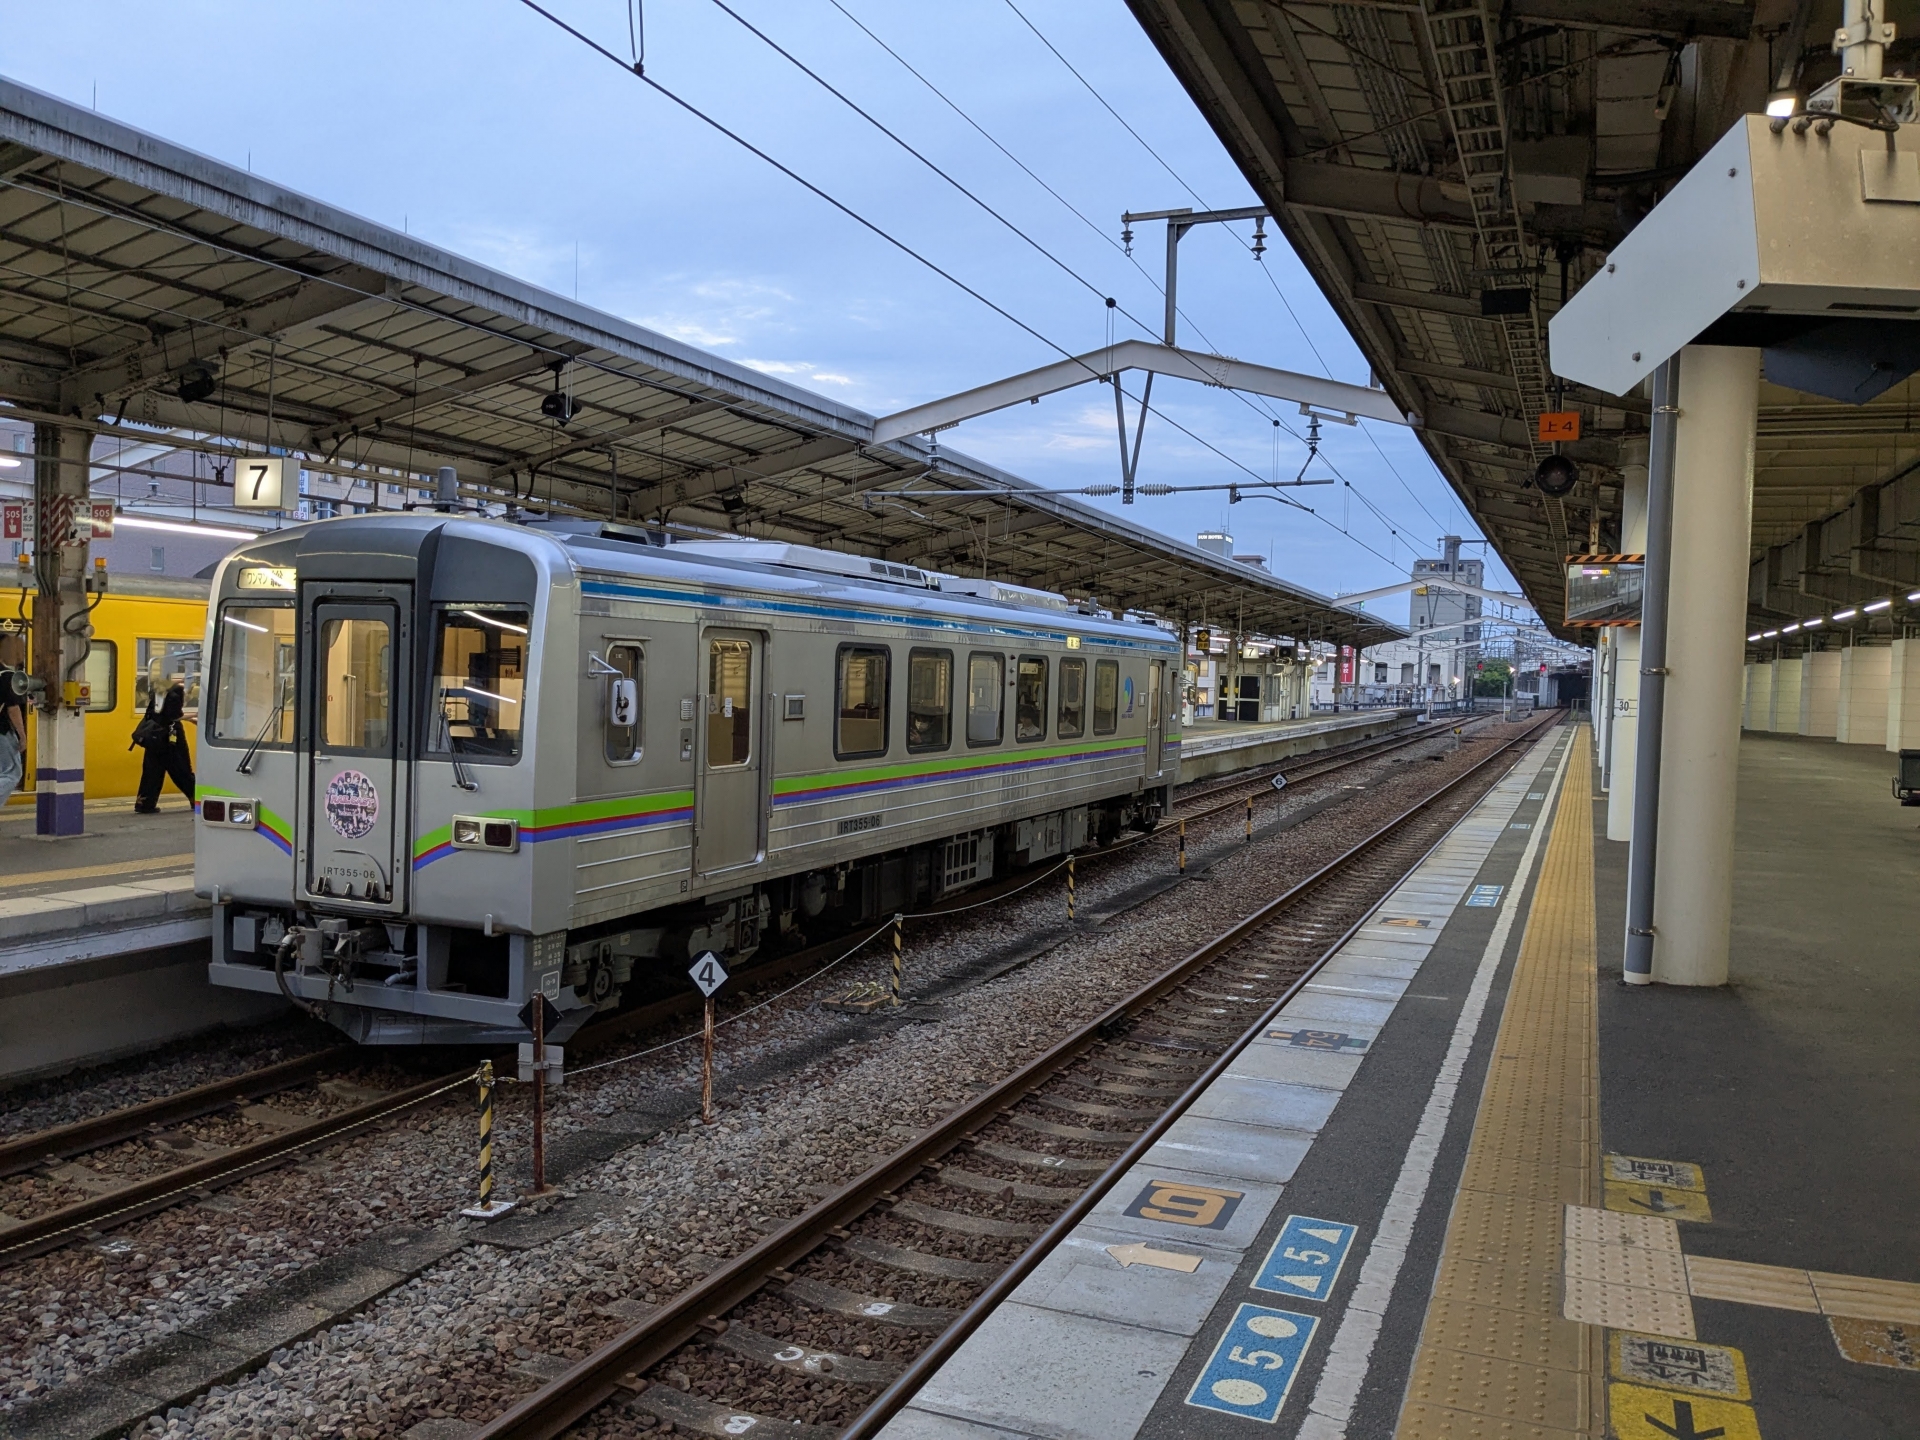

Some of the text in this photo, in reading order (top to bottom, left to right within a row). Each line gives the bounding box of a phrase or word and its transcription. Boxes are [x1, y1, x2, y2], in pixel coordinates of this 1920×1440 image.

[249, 465, 269, 500] 7
[6, 510, 20, 518] SOS
[94, 509, 110, 518] SOS
[1247, 647, 1255, 657] 7
[1619, 701, 1629, 711] 30
[840, 815, 881, 834] IRT355-06
[323, 866, 376, 878] IRT355-06
[698, 961, 716, 987] 4
[1283, 1246, 1330, 1265] 5
[1228, 1345, 1284, 1370] 5
